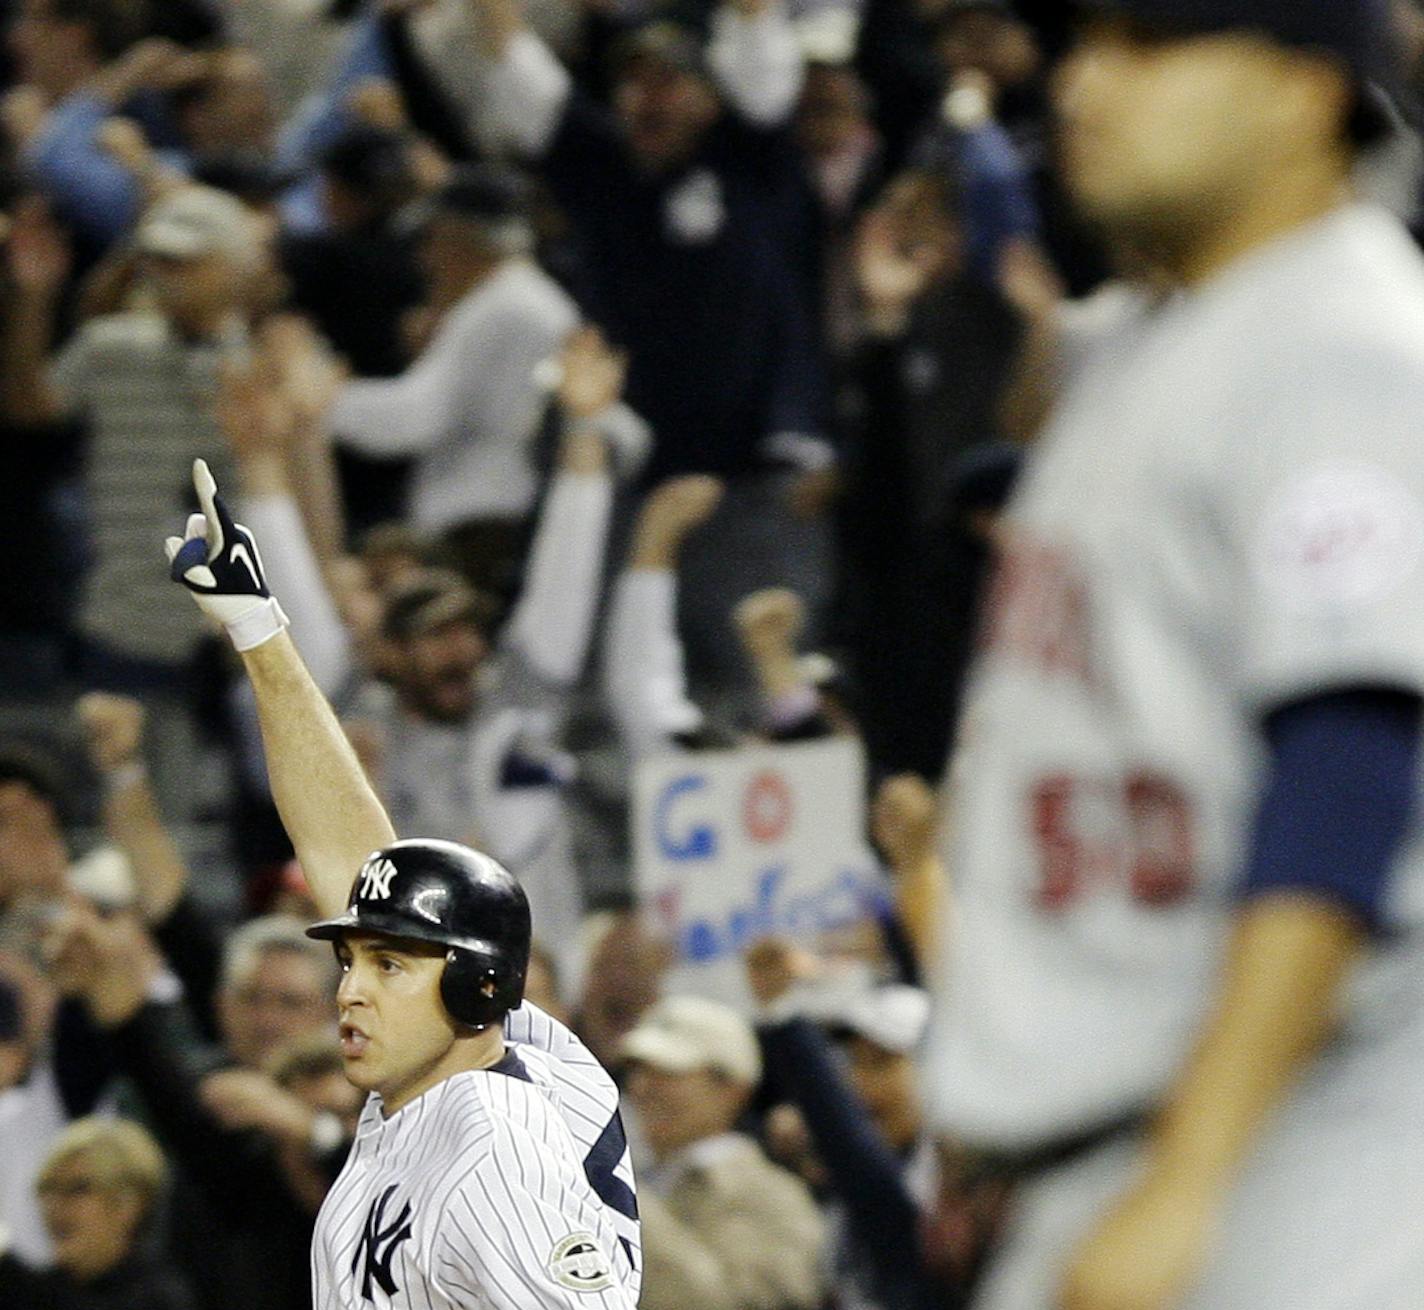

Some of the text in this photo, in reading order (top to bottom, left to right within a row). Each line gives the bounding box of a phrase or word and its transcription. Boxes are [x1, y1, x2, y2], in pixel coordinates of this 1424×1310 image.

[654, 774, 794, 863] GO
[1030, 768, 1197, 910] 50
[359, 858, 398, 900] NY
[351, 1182, 412, 1302] NY
